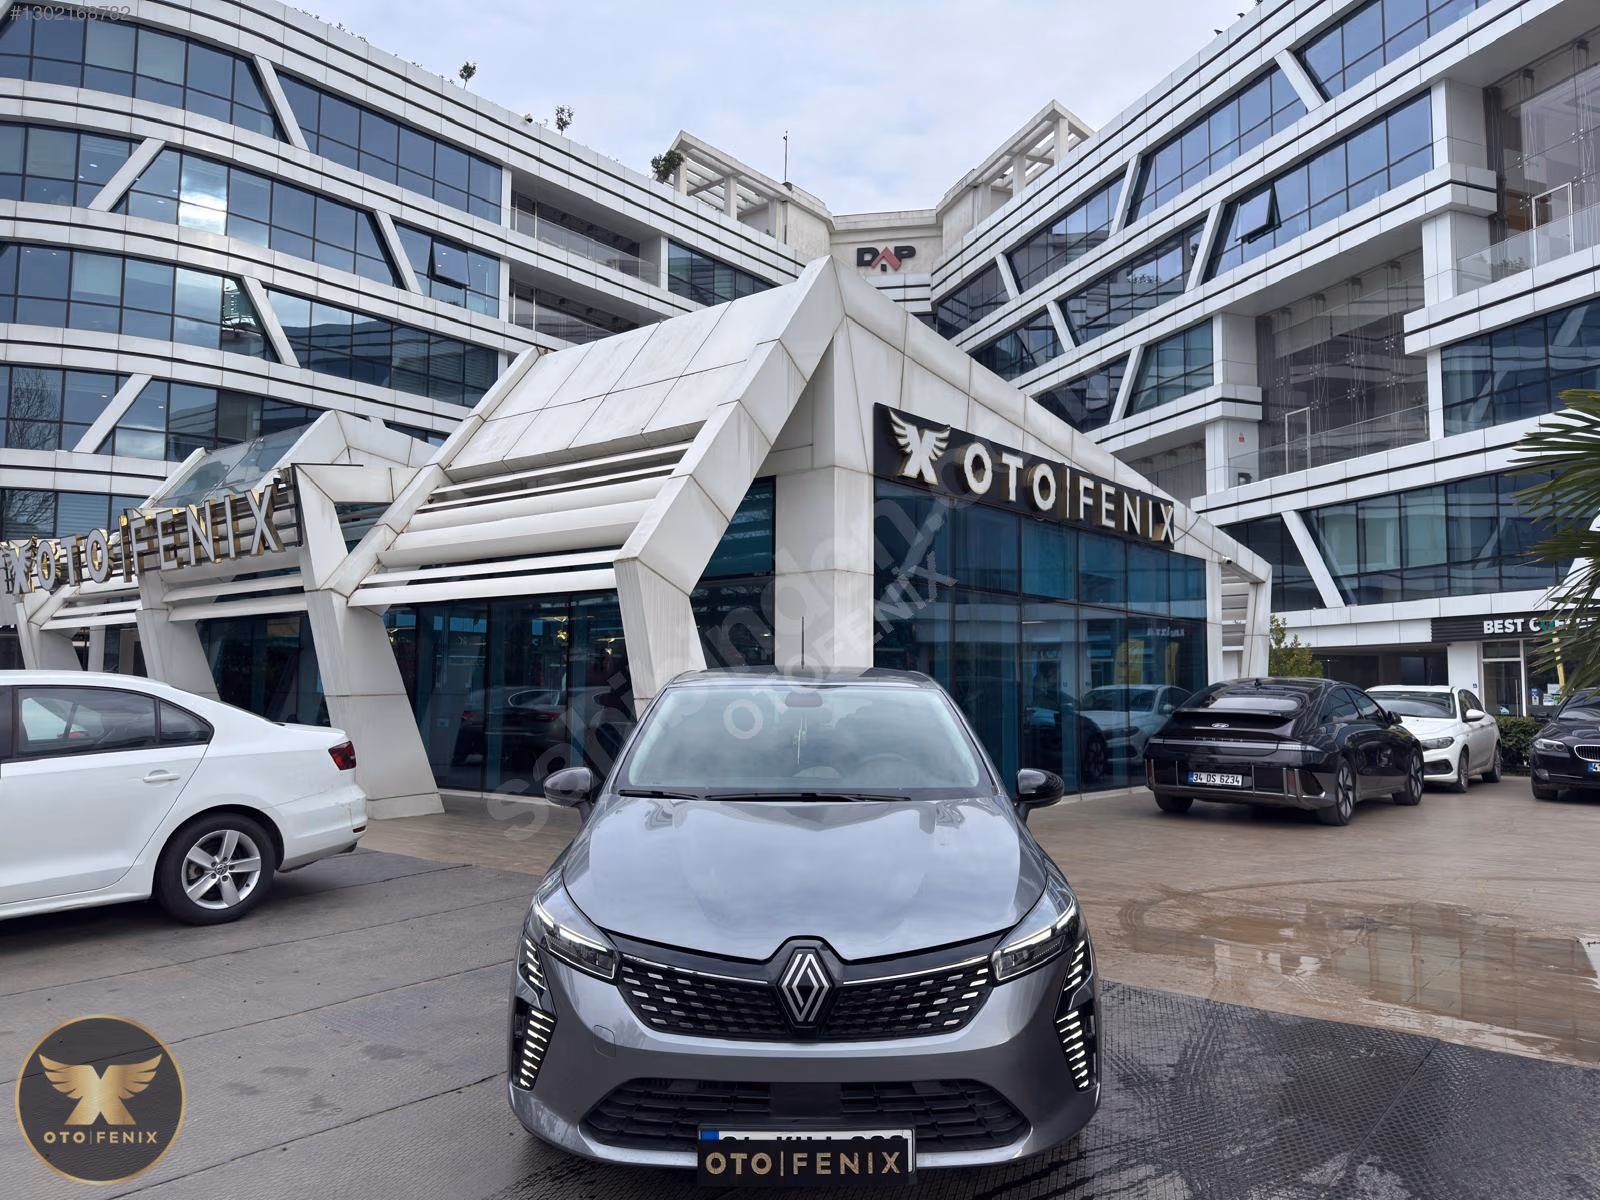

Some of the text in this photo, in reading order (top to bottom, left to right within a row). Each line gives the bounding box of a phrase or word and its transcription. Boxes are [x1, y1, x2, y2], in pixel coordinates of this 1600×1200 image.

[1483, 618, 1524, 634] BEST
[1193, 773, 1240, 785] 34 DS 6234
